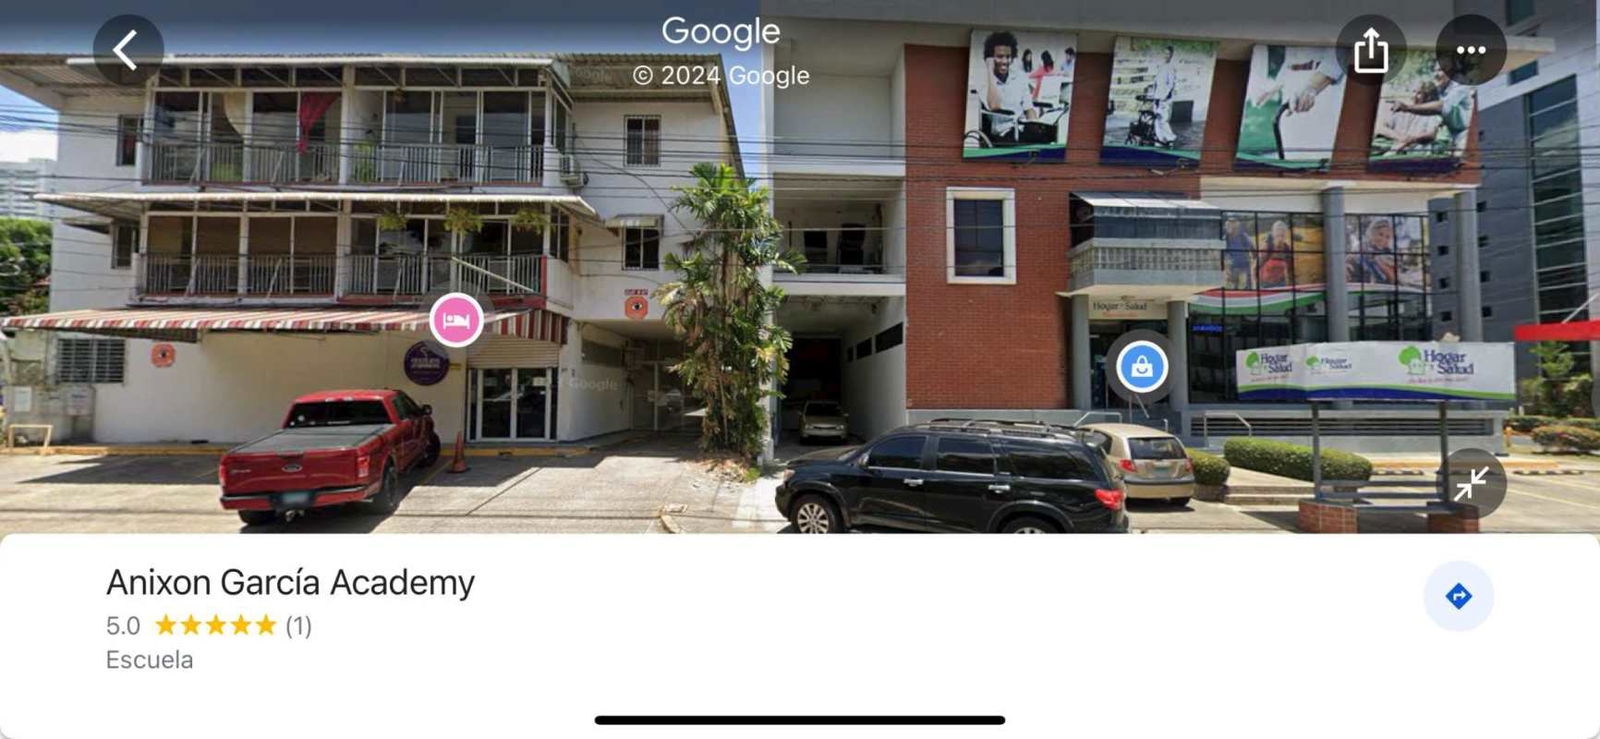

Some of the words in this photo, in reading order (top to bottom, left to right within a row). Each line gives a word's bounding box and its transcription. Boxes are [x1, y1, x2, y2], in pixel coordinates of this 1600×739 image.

[1260, 353, 1288, 364] Hogar
[1424, 349, 1467, 365] Hogar
[1269, 363, 1292, 373] Salud
[1437, 362, 1474, 374] Salud
